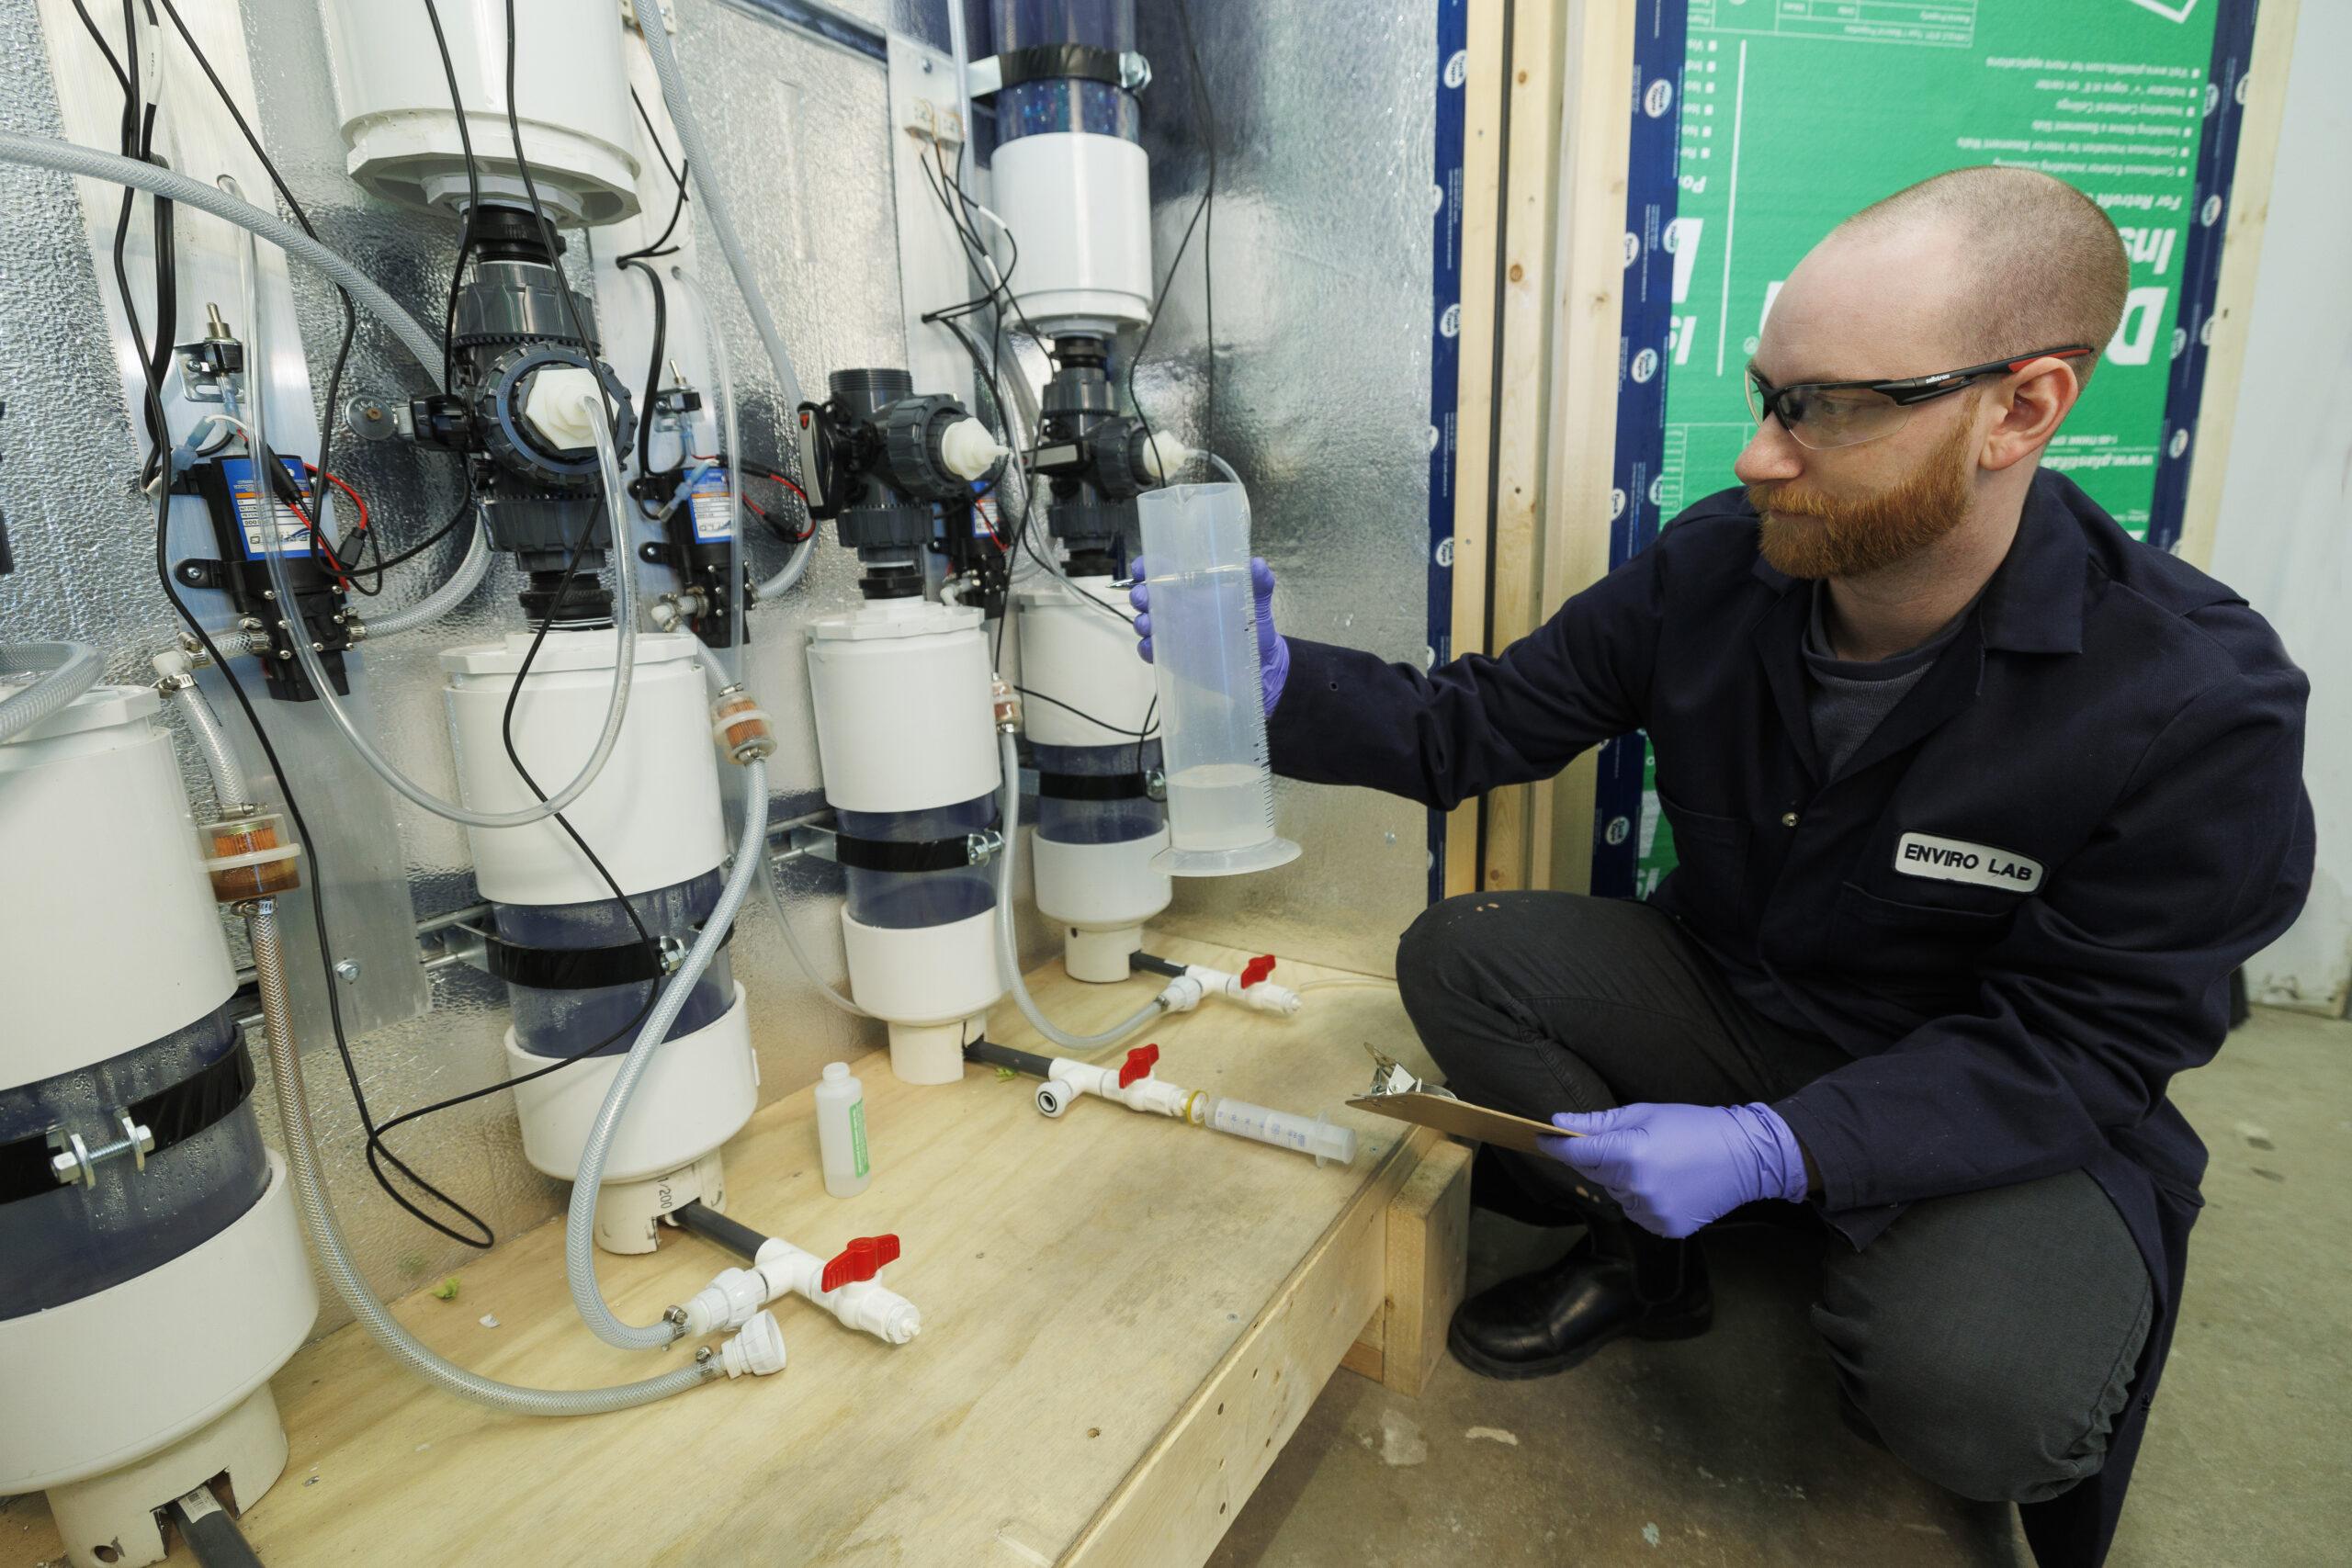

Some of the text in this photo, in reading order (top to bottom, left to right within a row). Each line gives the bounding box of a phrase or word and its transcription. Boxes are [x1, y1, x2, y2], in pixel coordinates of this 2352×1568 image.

[2097, 192, 2182, 210] For Retrofit
[1905, 843, 2032, 881] ENVIRO LAB
